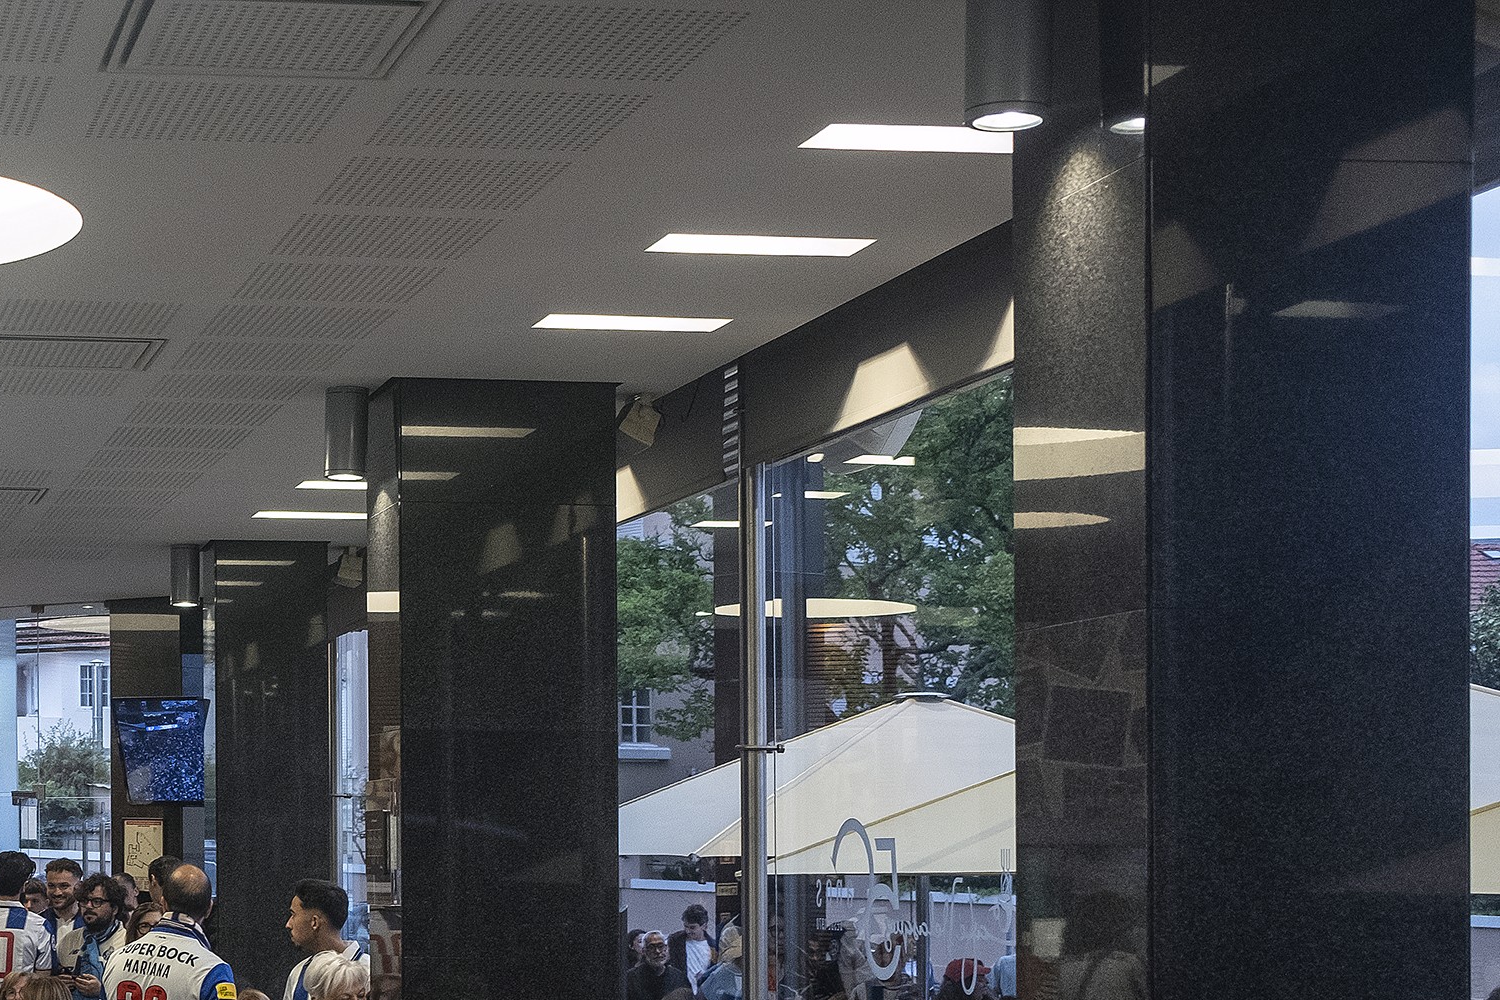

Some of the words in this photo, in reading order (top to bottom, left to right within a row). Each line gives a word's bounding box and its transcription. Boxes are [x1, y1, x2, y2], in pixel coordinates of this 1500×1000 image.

[119, 943, 155, 957] SUPER
[156, 945, 199, 968] BOCK
[122, 958, 172, 979] MARIANA
